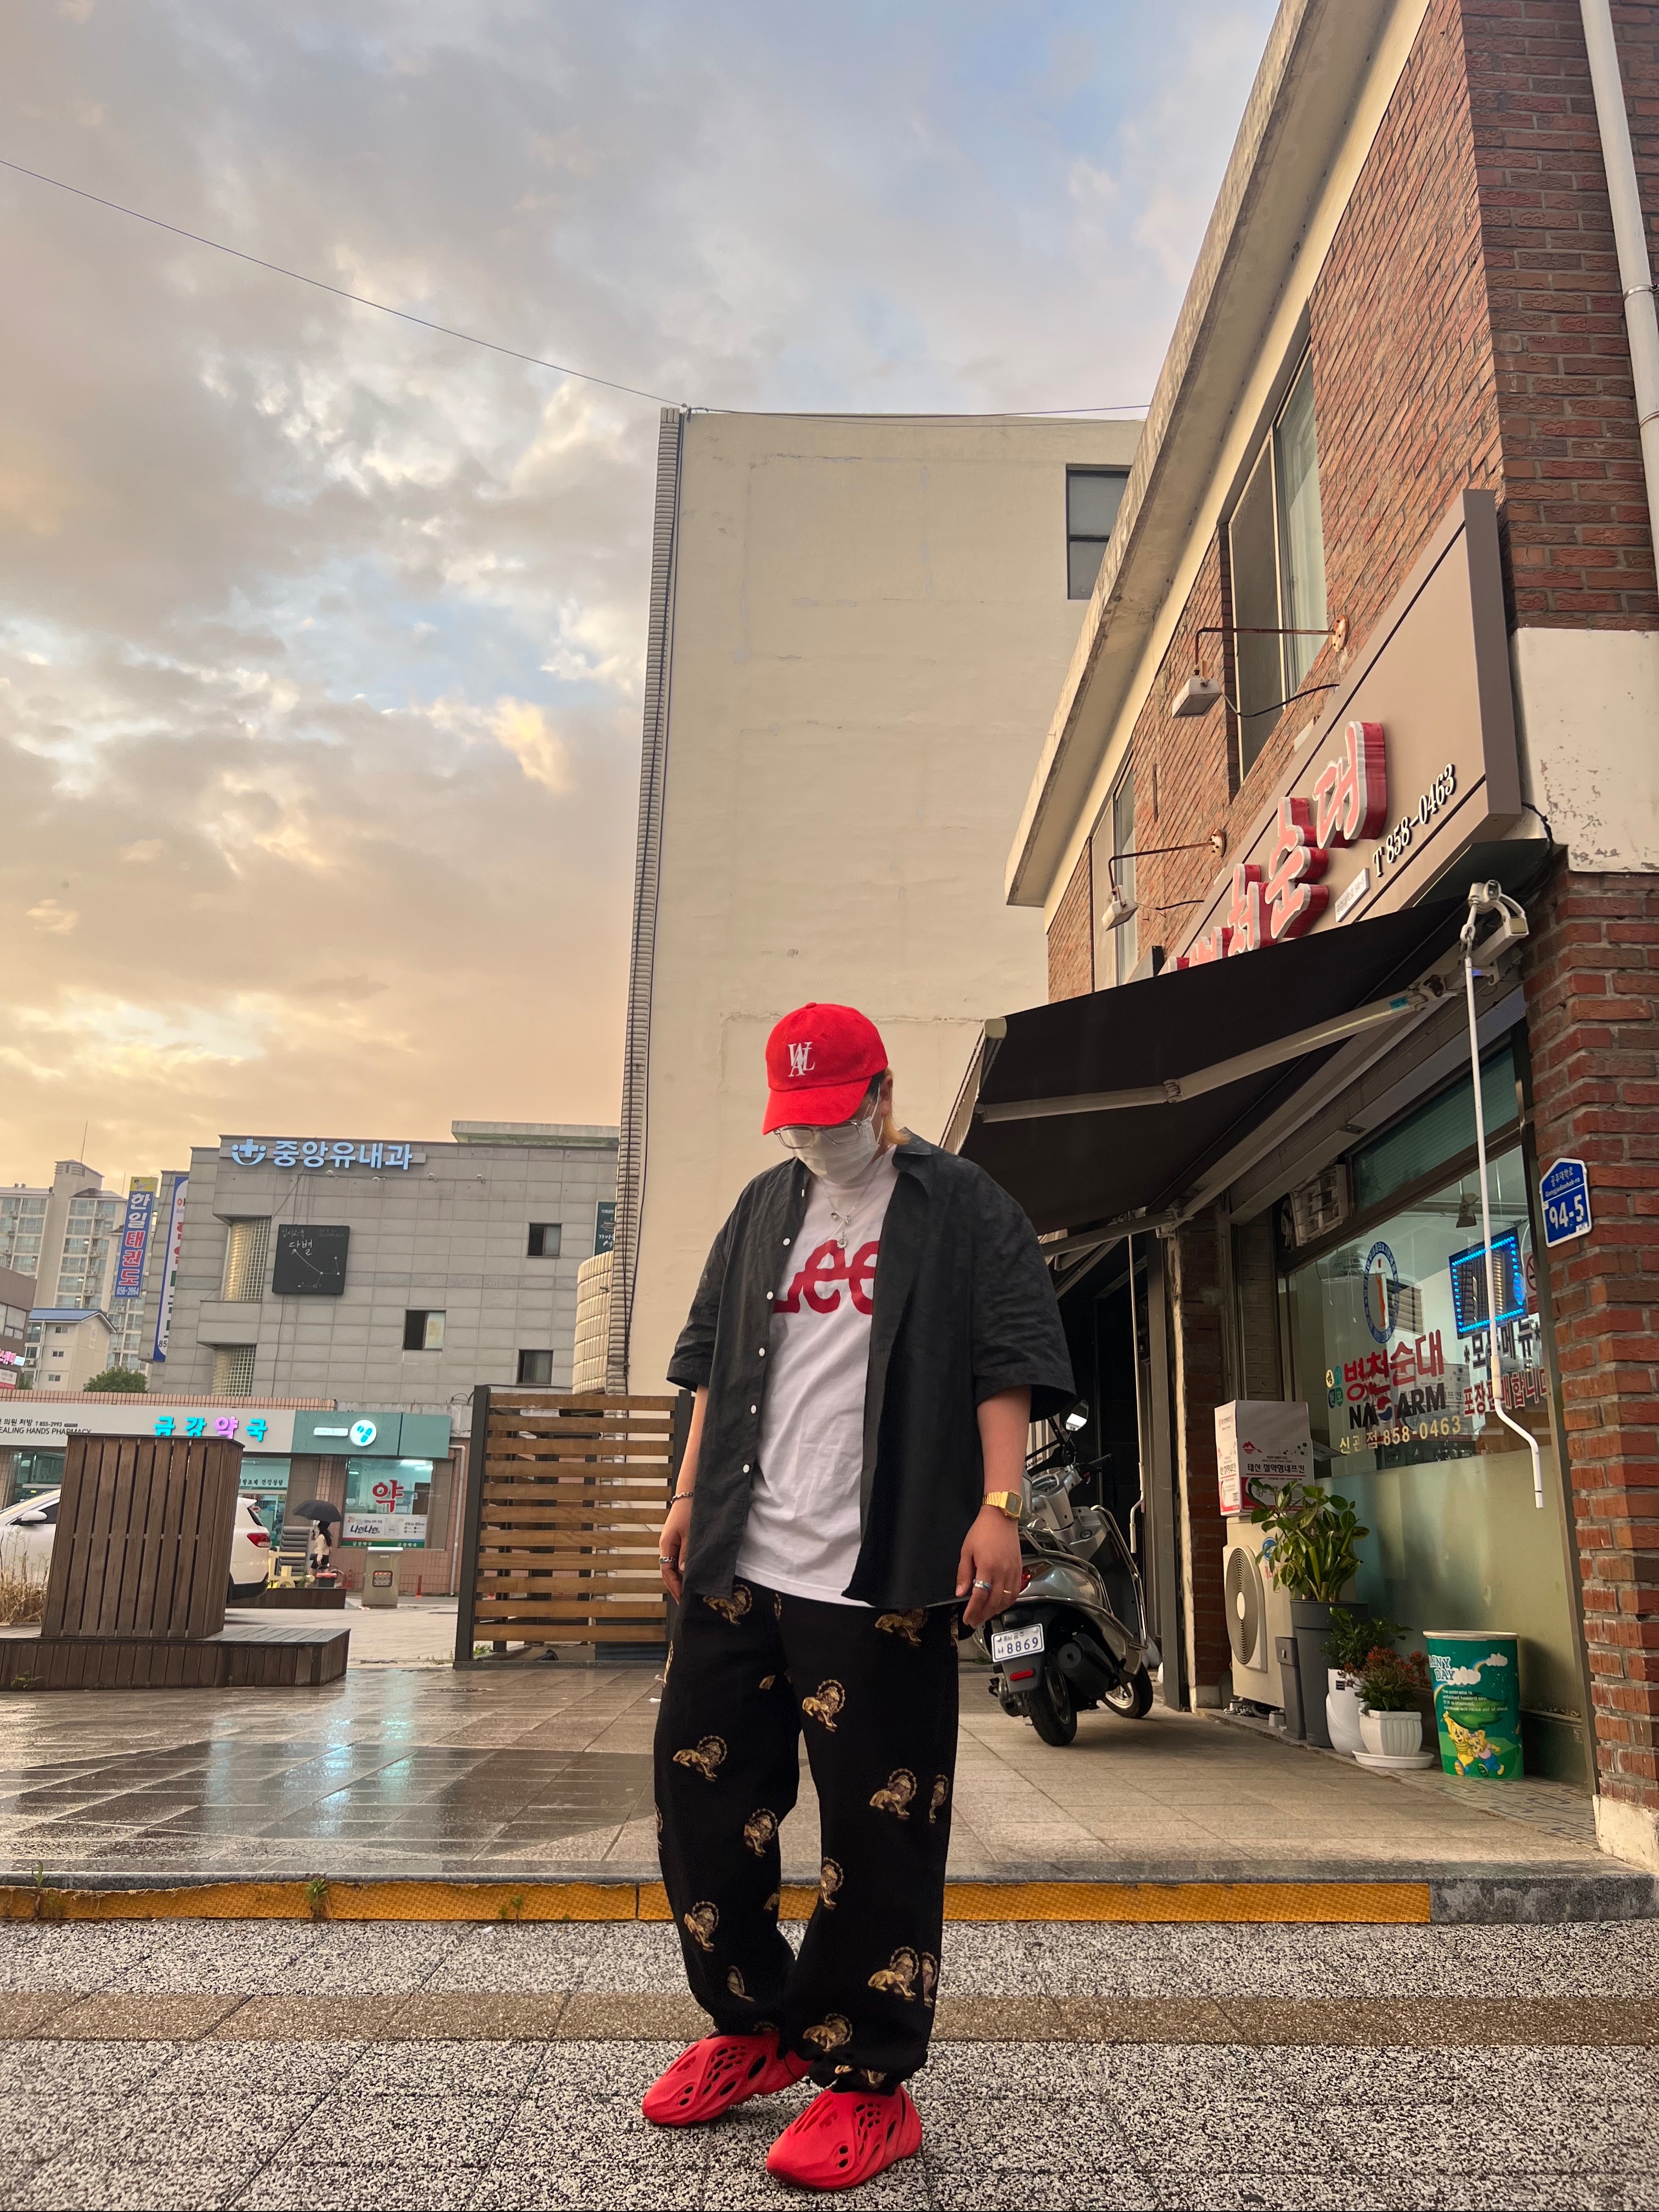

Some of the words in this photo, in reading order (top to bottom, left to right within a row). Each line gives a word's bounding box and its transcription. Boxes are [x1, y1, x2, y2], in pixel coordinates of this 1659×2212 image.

[1373, 848, 1384, 878] T
[1386, 763, 1457, 865] 858-0463
[273, 1140, 413, 1171] 중앙유내과
[1545, 1177, 1581, 1197] Gongjudaehak-ro
[1550, 1166, 1574, 1187] 공주대학로
[1549, 1194, 1585, 1230] 94-5
[119, 1193, 151, 1286] 한일태권도
[1464, 1318, 1541, 1369] 모메뉴
[1344, 1329, 1444, 1402] 병천순대
[4, 1418, 17, 1426] 의원
[154, 1416, 268, 1442] 금강약국
[1383, 1415, 1461, 1446] 858-0463
[373, 1480, 404, 1514] 약
[1007, 1637, 1038, 1654] 8869
[1434, 1668, 1455, 1681] DAY
